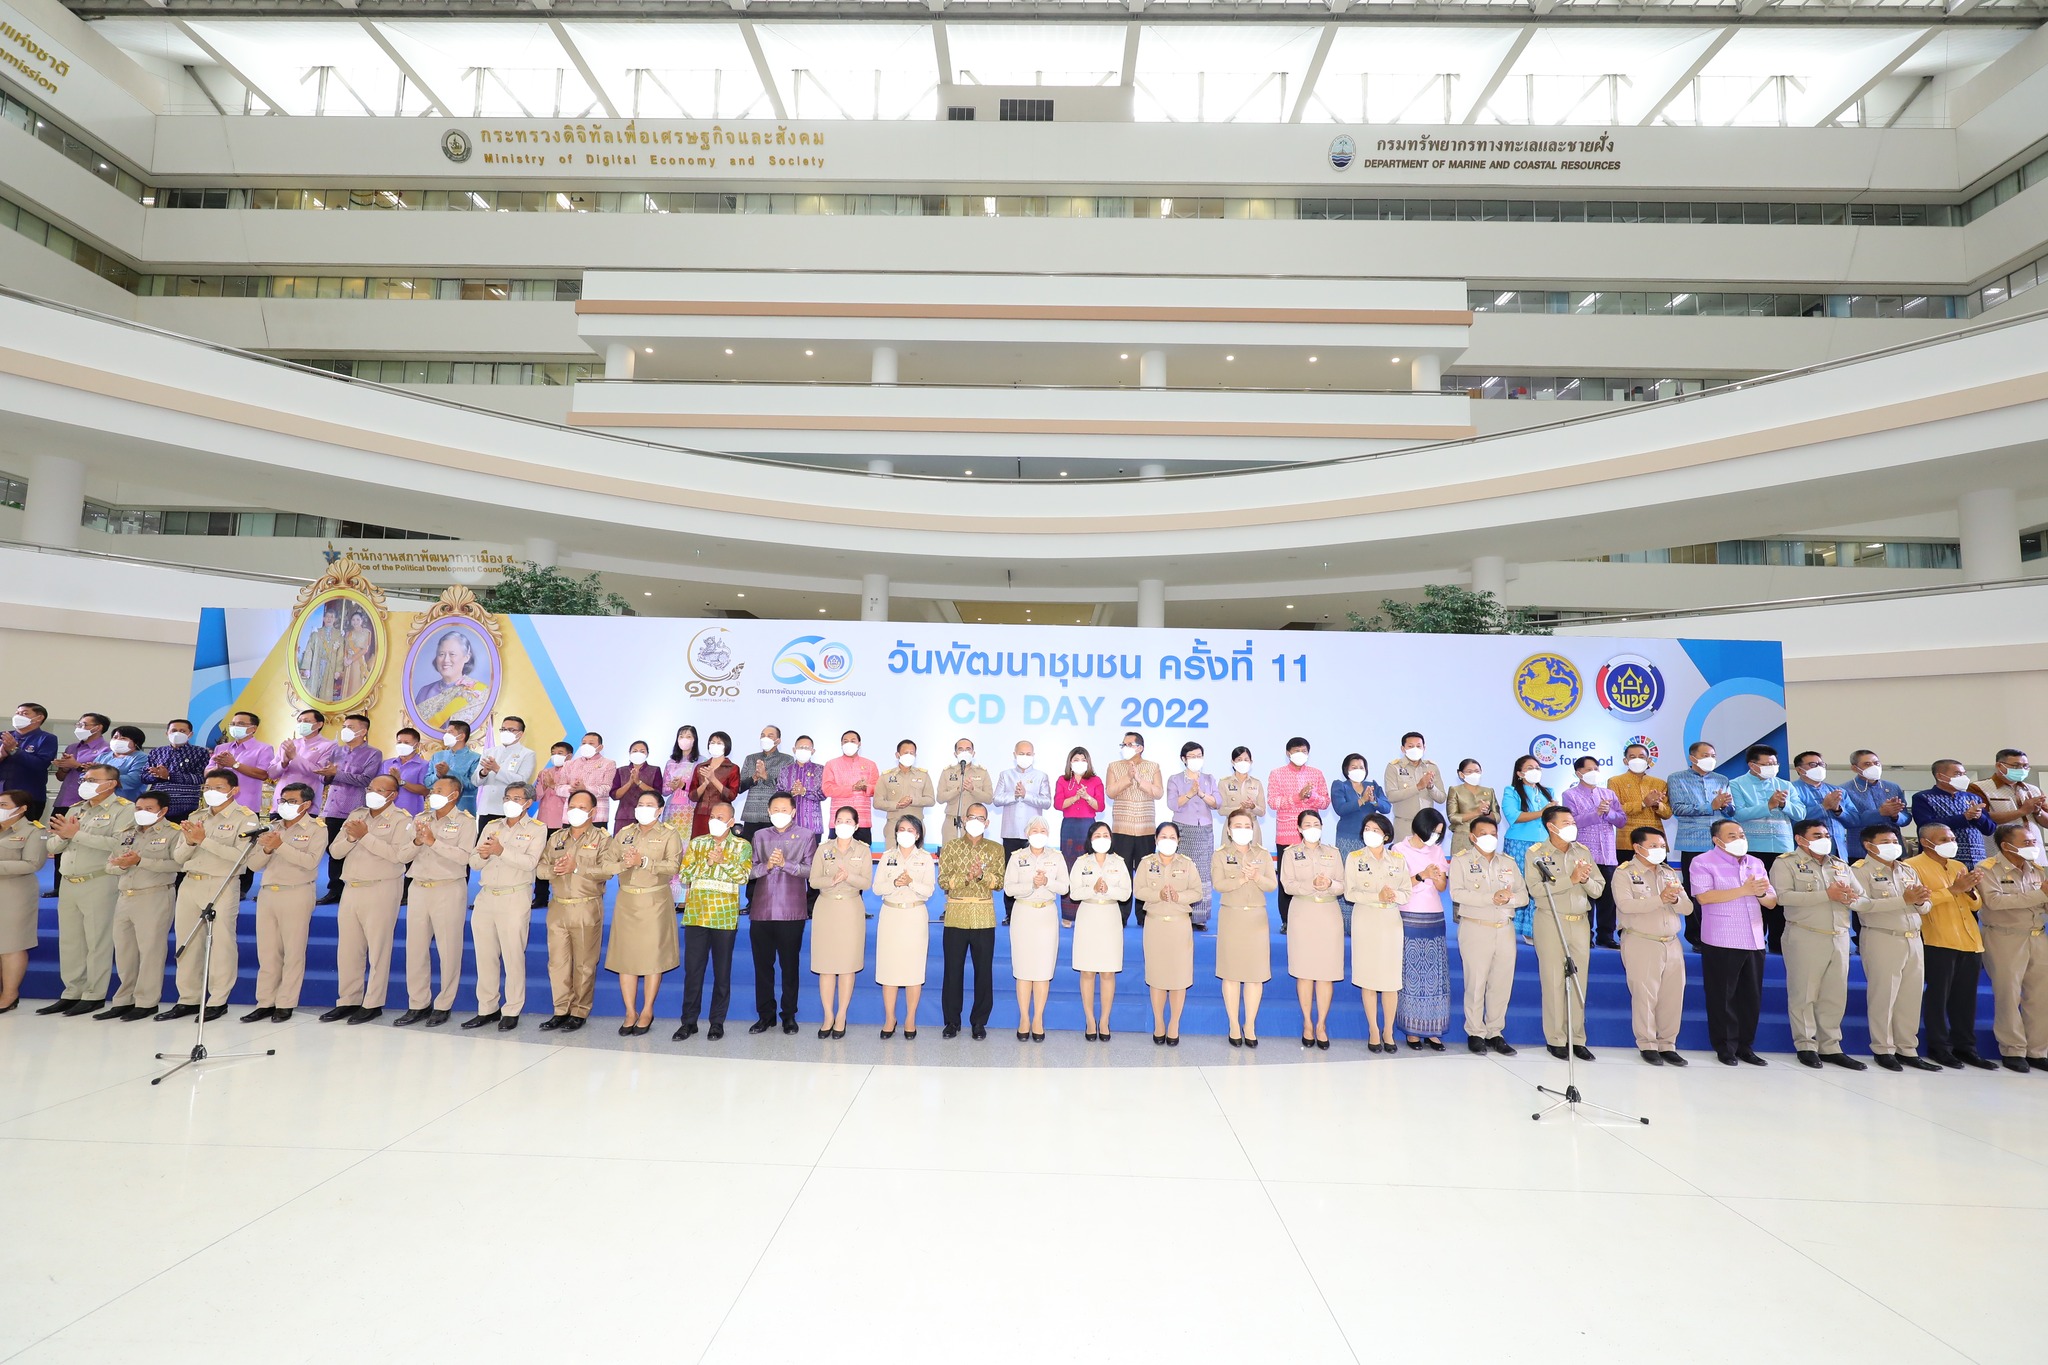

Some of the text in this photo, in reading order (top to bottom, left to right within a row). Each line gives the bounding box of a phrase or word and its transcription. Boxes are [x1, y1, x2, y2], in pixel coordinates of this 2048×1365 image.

[0, 21, 70, 77] แห่งชาติ
[480, 119, 825, 151] กระทรวงดิจิทัลเพื่อเศรษฐกิจและสังคม
[1377, 131, 1615, 153] กรมทรัพยากรทางทะเลและชายฝั่ง
[484, 153, 545, 166] Ministry
[558, 154, 573, 164] of
[586, 154, 637, 167] Digital
[649, 155, 716, 168] Economy
[729, 156, 755, 166] and
[769, 156, 825, 168] Society
[1364, 159, 1621, 170] DEPARTMENT OF MARINE AND COASTAL RESOURCES
[395, 564, 425, 572] Political
[426, 565, 475, 573] Development
[888, 638, 1306, 688] วันพัฒนาชุมชน ครั้งที่ 11
[948, 692, 1209, 729] CD DAY 2022
[1559, 754, 1577, 766] for
